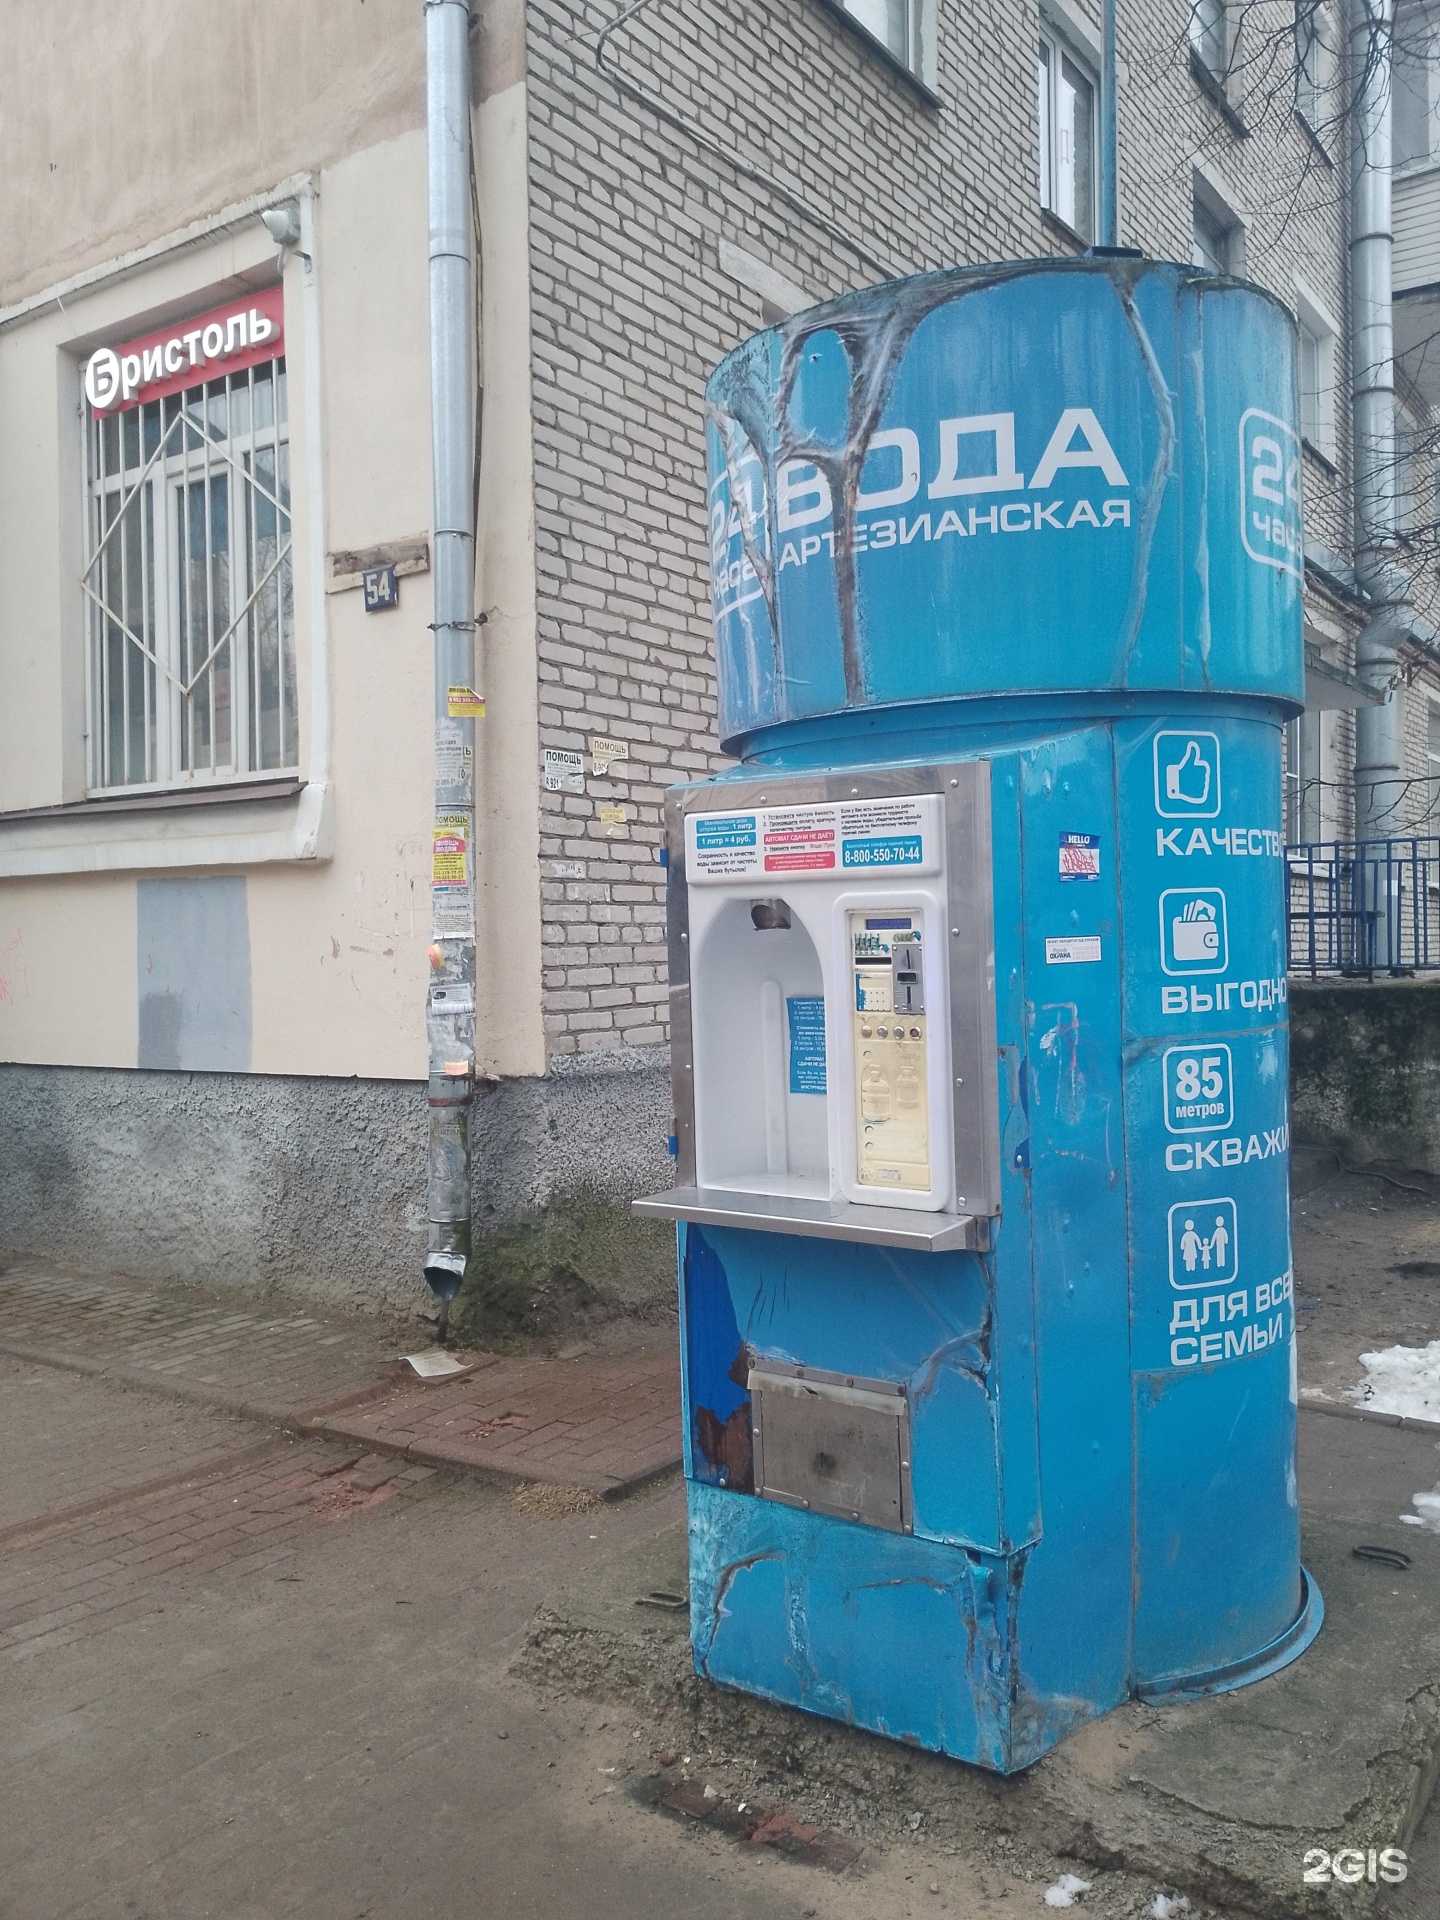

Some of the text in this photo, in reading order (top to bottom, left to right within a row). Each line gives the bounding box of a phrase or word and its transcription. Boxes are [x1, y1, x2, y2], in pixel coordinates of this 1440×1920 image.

[85, 308, 272, 408] Бристоль
[778, 408, 1130, 533] ВОДА
[779, 499, 1130, 572] АРТЕЗИАНСКАЯ
[367, 571, 390, 605] 54
[546, 751, 581, 766] ПОМОЩЬ
[594, 740, 626, 754] ПОМОЩЬ
[707, 838, 723, 846] литр
[845, 846, 920, 863] 8-800-550-70-44
[1068, 835, 1090, 845] HELLO
[1161, 977, 1287, 1014] ВЫГОДНО
[1176, 1056, 1223, 1101] 85
[1176, 1103, 1225, 1119] метров
[1169, 1290, 1248, 1335] ДЛЯ
[1170, 1313, 1283, 1366] СЕМЬИ
